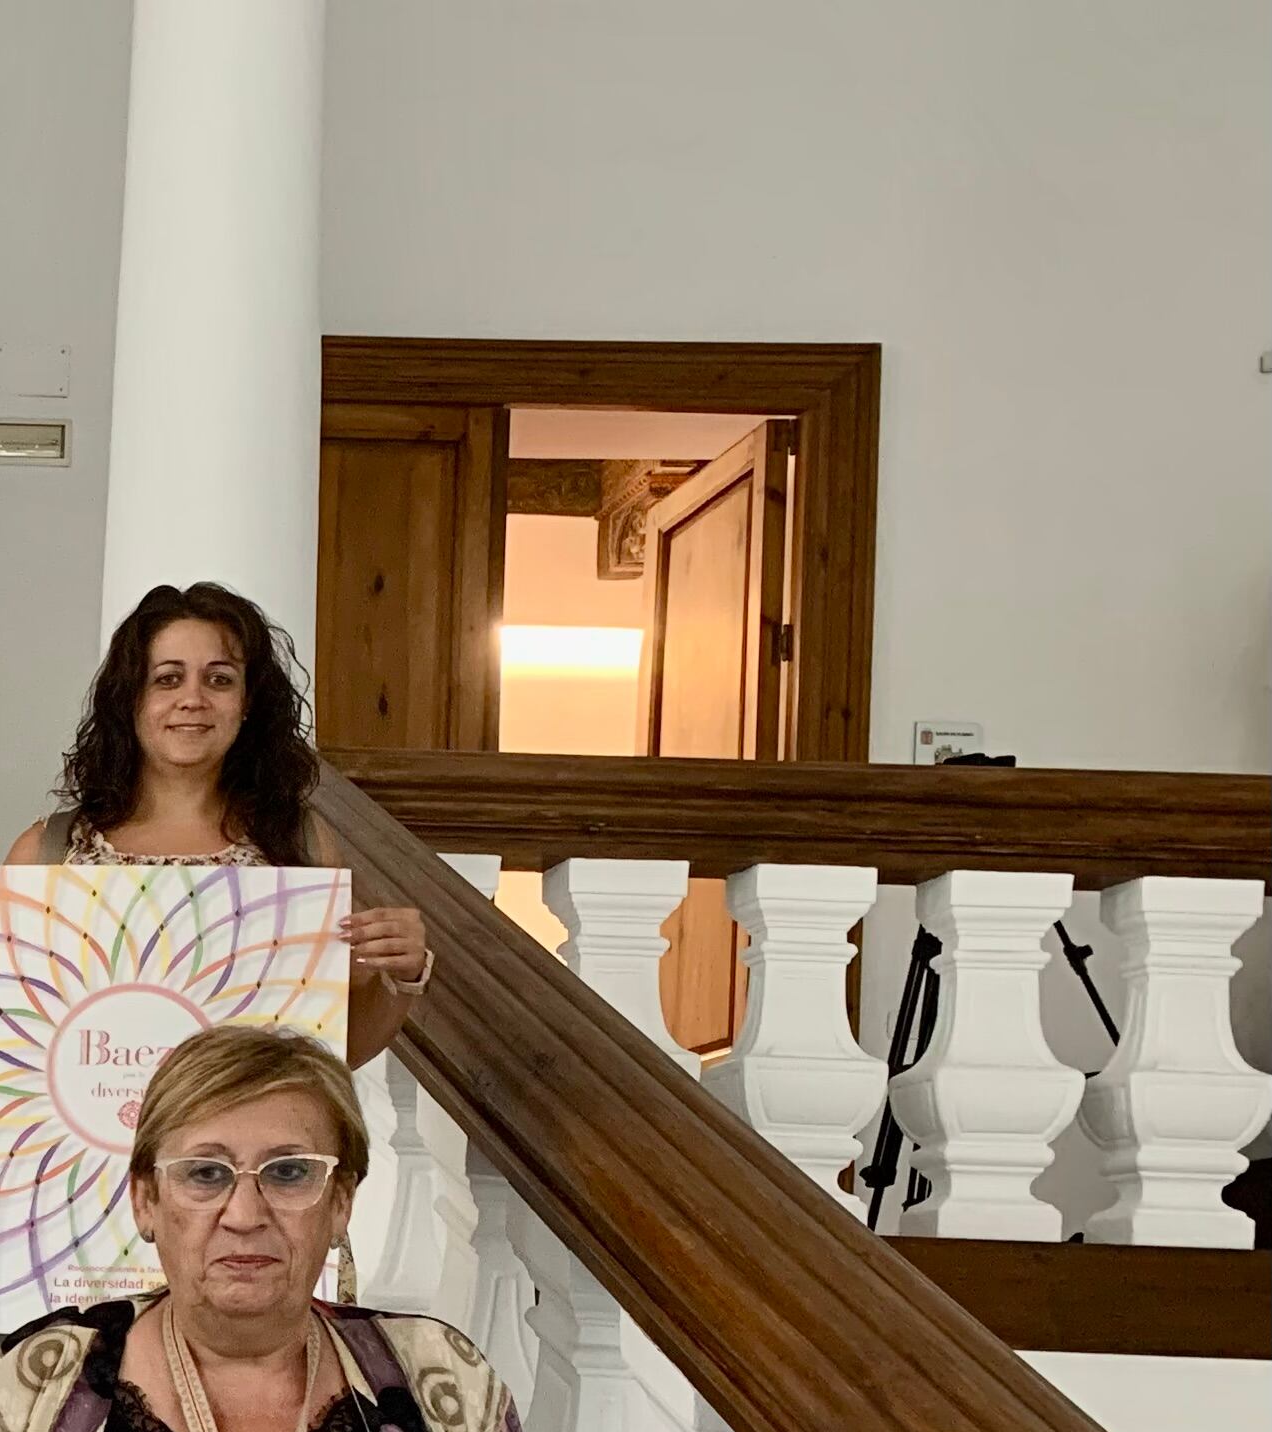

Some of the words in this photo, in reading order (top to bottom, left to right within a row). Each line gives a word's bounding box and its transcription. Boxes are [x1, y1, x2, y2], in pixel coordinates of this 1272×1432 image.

[54, 1277, 70, 1288] La
[74, 1277, 143, 1289] diversidad
[49, 1292, 62, 1304] la
